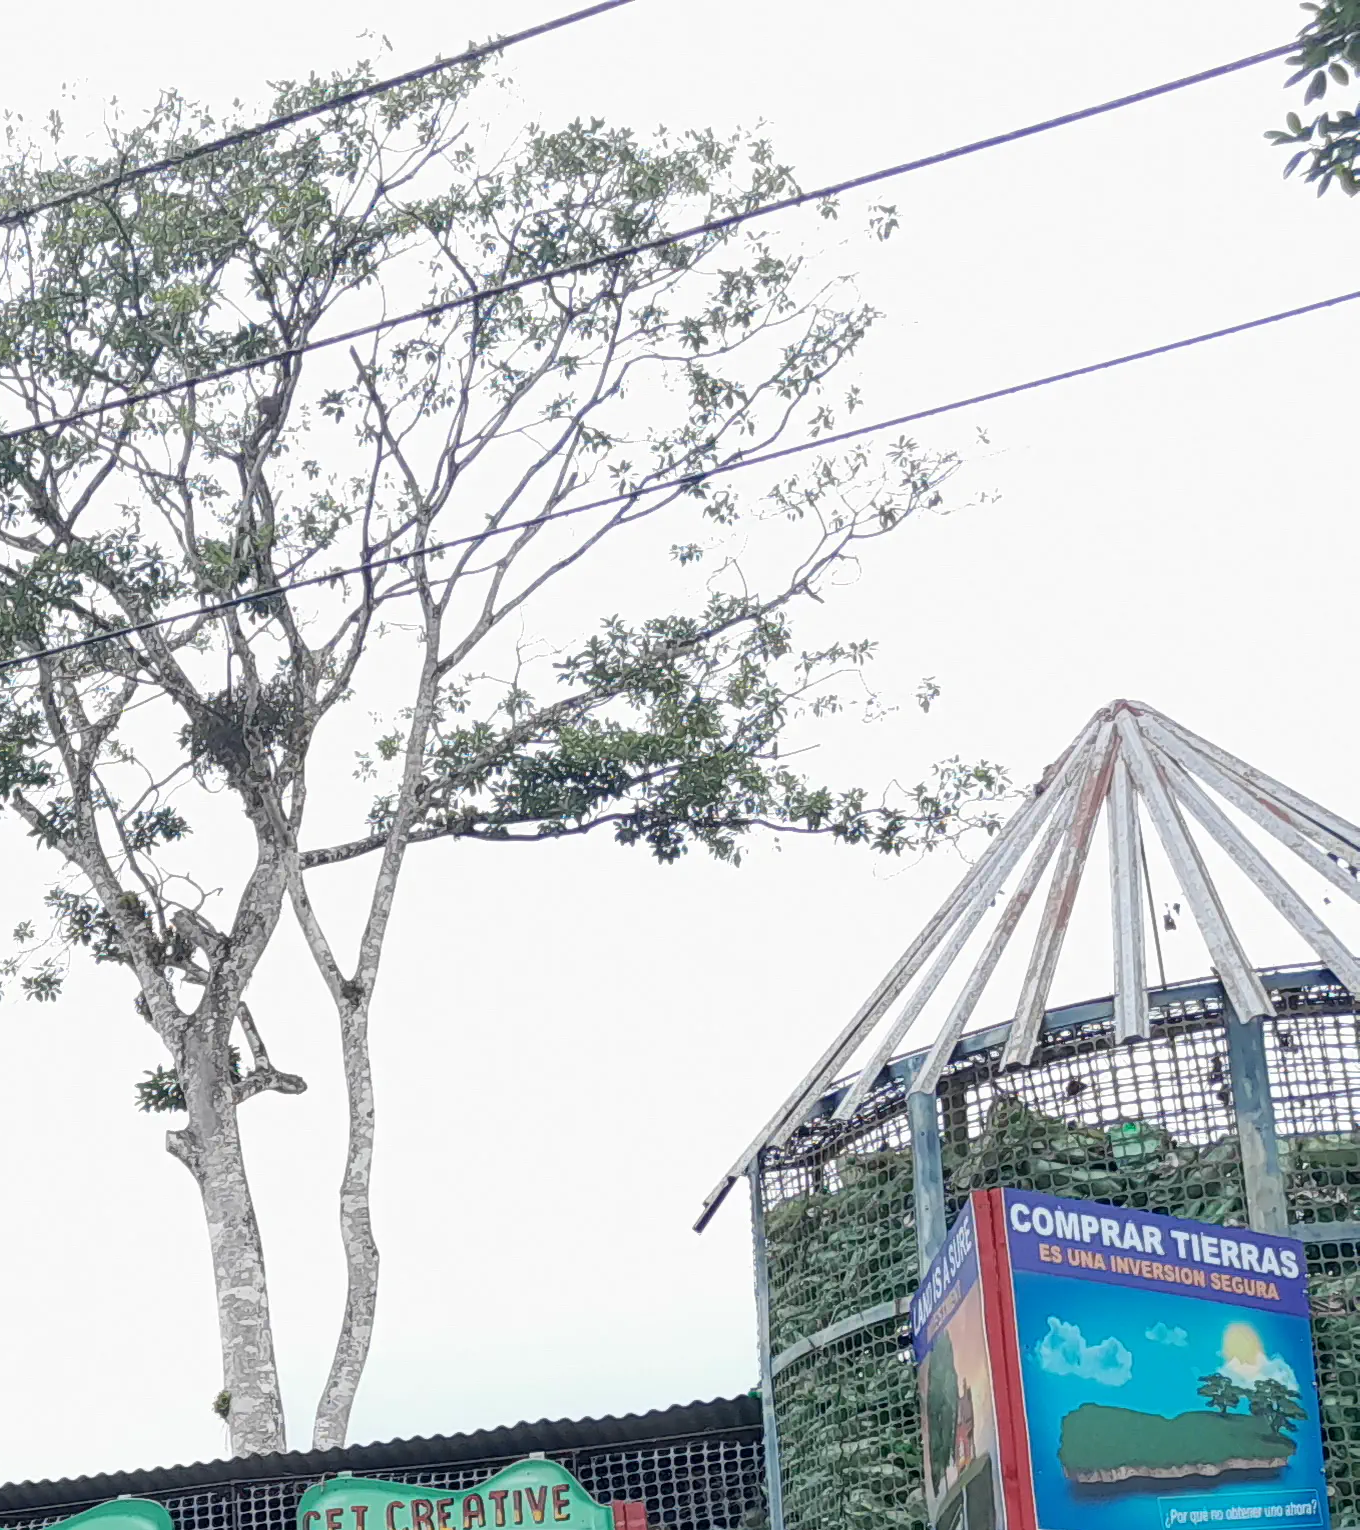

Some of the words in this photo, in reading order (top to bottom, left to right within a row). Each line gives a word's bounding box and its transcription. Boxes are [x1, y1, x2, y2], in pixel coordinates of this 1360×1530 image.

[1010, 1203, 1165, 1256] COMPRAR
[1170, 1230, 1300, 1279] TIERRAS
[1039, 1244, 1062, 1263] ES
[1067, 1248, 1106, 1271] UNA
[1111, 1255, 1206, 1288] INVERSION
[1210, 1272, 1280, 1300] SEGURA
[1211, 1509, 1223, 1520] no
[1264, 1506, 1283, 1517] uno
[1285, 1499, 1317, 1517] ahora?
